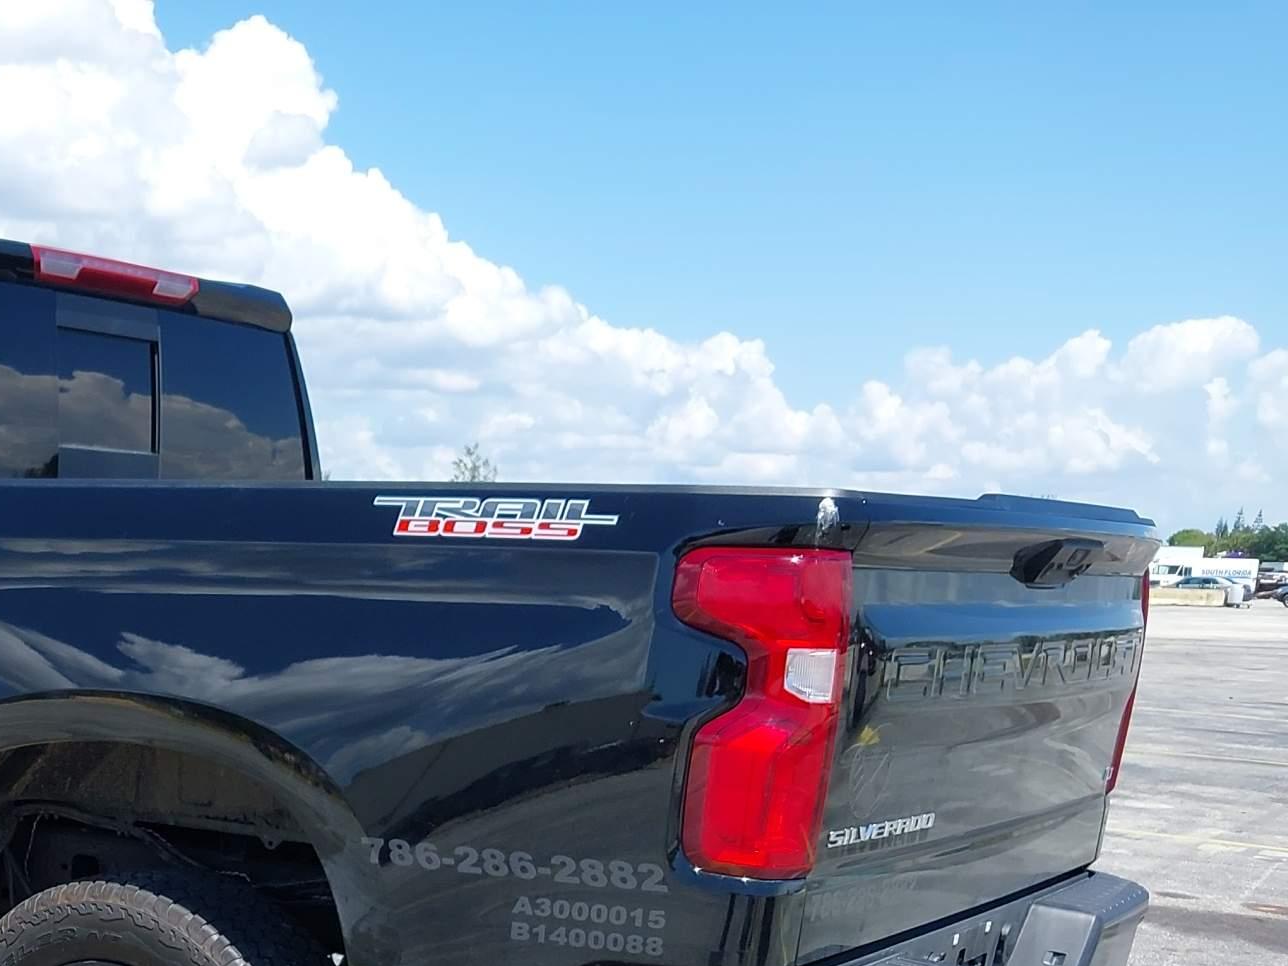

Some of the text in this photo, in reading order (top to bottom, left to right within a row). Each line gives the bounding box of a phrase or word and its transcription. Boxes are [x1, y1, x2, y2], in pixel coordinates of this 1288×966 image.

[373, 495, 619, 526] TRAIL
[393, 517, 585, 541] BOSS
[827, 812, 935, 849] SILVERADO
[361, 836, 669, 894] 786-286-2882
[511, 896, 666, 929] A3000015
[510, 921, 664, 956] B1400088
